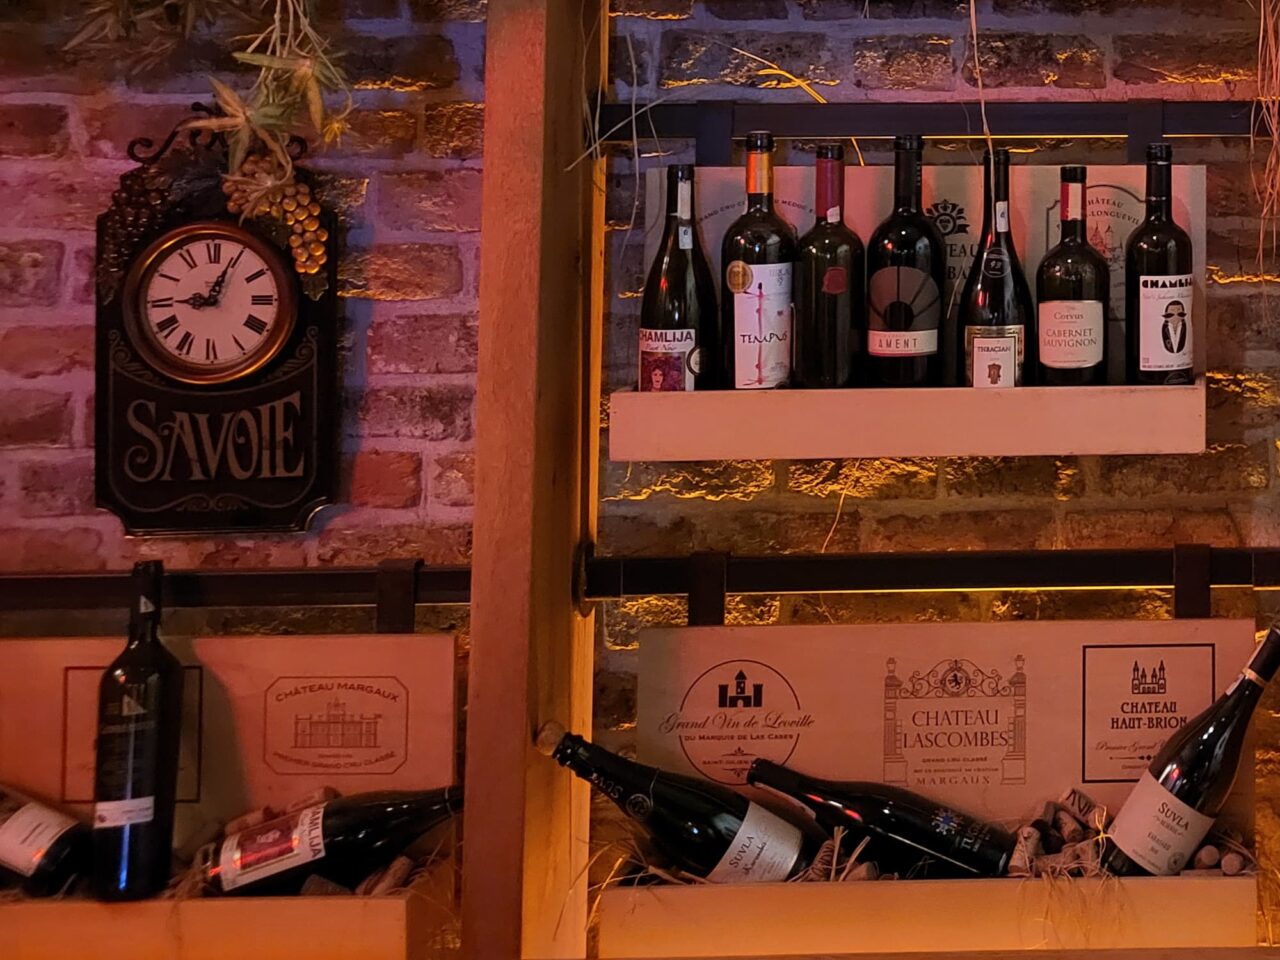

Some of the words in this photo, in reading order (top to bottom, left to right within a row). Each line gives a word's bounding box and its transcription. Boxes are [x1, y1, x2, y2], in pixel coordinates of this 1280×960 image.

[1088, 197, 1124, 208] HÂTEAU
[1054, 312, 1084, 320] Corvus
[640, 330, 694, 343] CHAMLIJA
[1045, 328, 1093, 337] CABERNET
[878, 339, 918, 349] AMENT
[1043, 338, 1097, 348] SAUVIGNON
[124, 392, 305, 482] SAVOIE
[337, 683, 399, 702] MARGAUX
[1121, 701, 1177, 714] CHATEAU
[658, 711, 711, 734] Grand
[711, 711, 741, 729] Vin
[743, 715, 759, 729] de
[911, 709, 999, 728] CHATEAU
[903, 731, 1009, 749] LASCOMBES
[917, 775, 990, 785] MARGAUX
[1158, 802, 1190, 831] SUVLA
[729, 836, 755, 868] SUVLA
